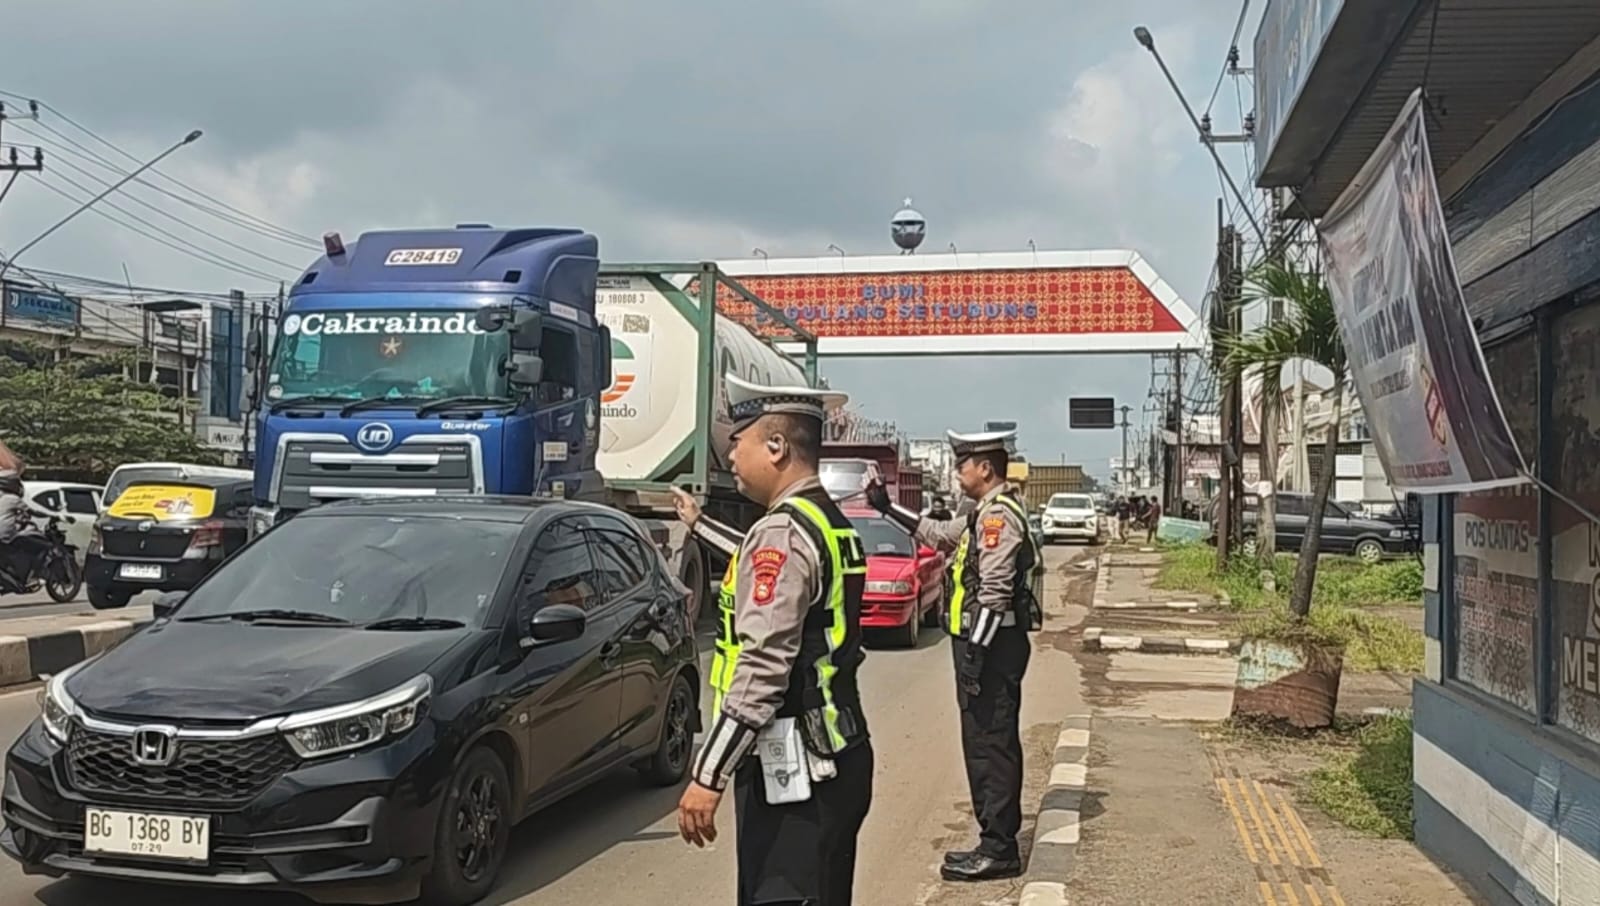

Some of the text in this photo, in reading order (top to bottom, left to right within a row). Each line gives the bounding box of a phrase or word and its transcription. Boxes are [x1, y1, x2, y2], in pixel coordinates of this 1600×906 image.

[389, 250, 459, 263] C28419
[863, 285, 925, 300] BUMI
[441, 422, 491, 431] Quester
[360, 430, 389, 443] UD
[1465, 521, 1486, 547] POS
[91, 813, 204, 845] BG 1368 BY
